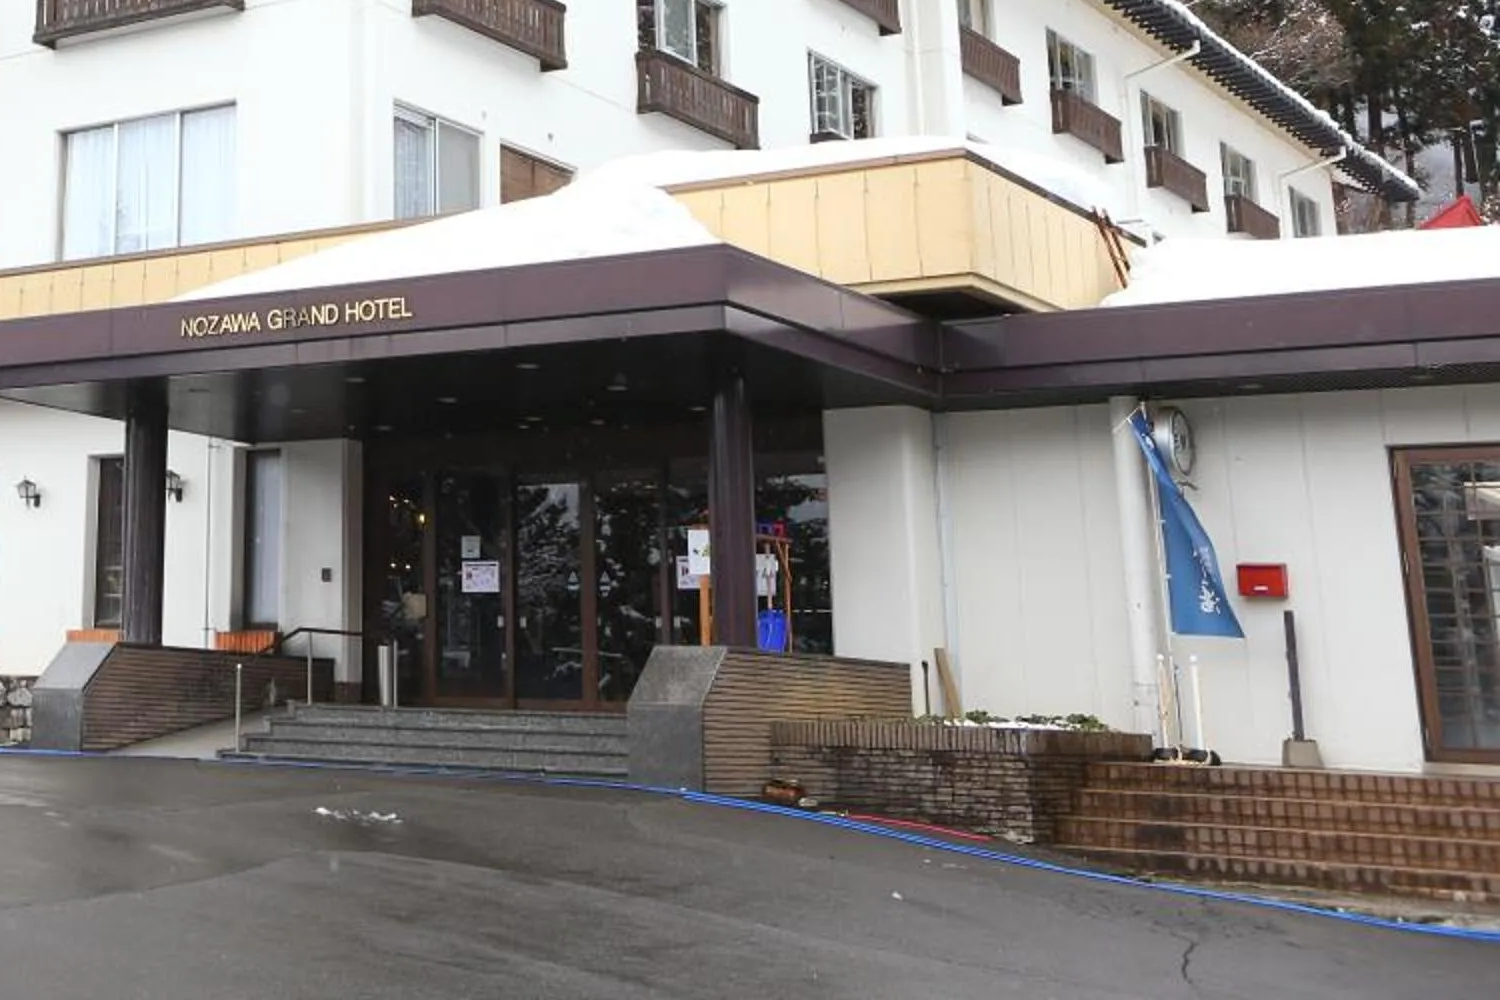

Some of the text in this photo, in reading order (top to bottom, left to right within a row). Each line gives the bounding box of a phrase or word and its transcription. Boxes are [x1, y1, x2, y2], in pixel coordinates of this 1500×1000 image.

[181, 297, 413, 337] NOZAWA GRAND HOTEL
